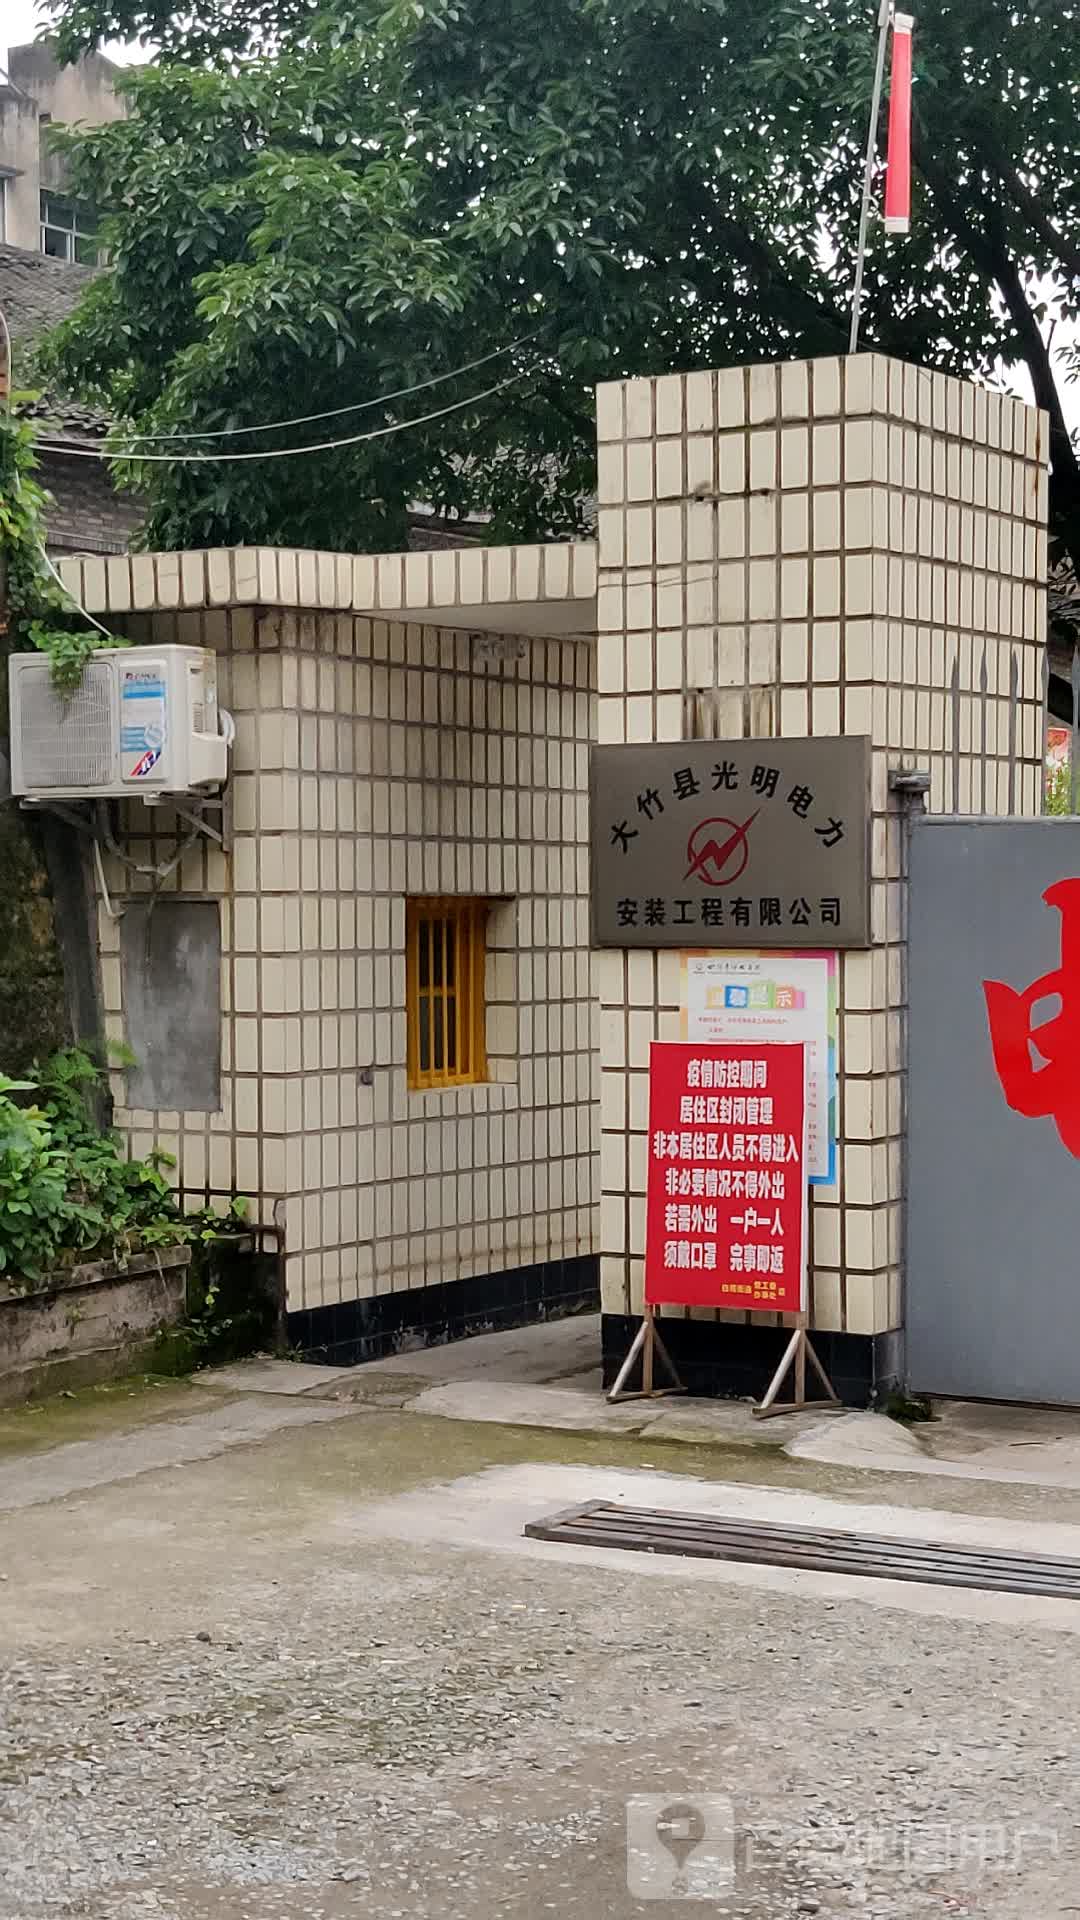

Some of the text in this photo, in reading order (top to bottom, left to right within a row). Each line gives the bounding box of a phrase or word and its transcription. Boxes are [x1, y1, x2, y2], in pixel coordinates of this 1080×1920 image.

[611, 760, 844, 853] 大竹县光明电力
[617, 897, 841, 927] 安装工程有限公司
[687, 1059, 767, 1088] 疫情防控期间
[680, 1096, 773, 1125] 居住区封闭管理
[653, 1131, 799, 1162] 非本居住区人员不得进入
[665, 1168, 785, 1199] 非必要情况不得外出
[665, 1203, 784, 1236] 若需外出 一户一人
[664, 1240, 784, 1273] 须戴口罩 完事即返
